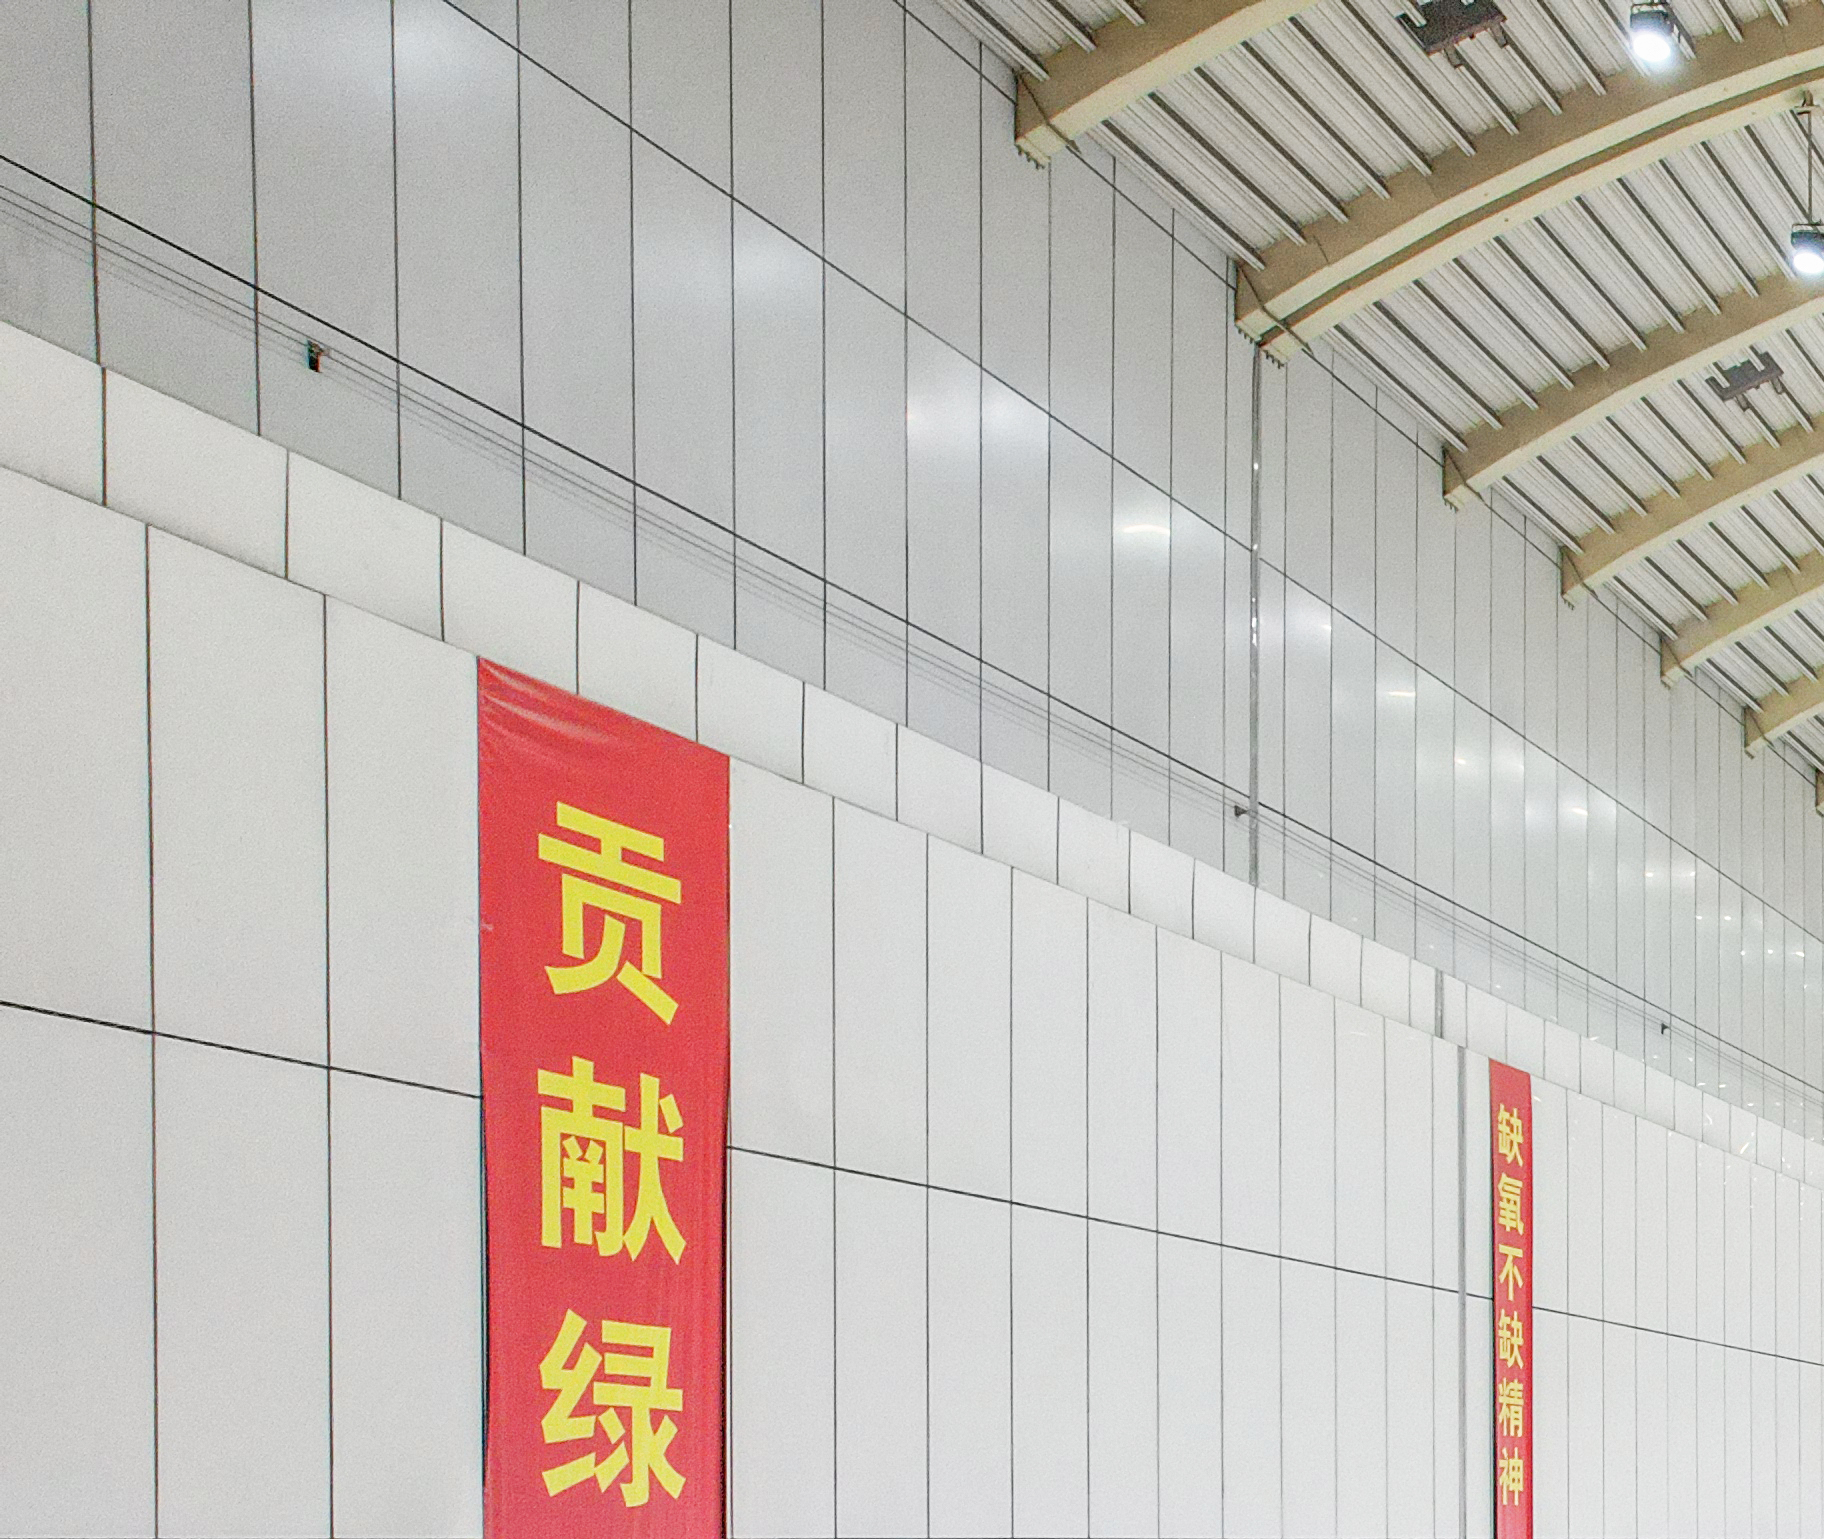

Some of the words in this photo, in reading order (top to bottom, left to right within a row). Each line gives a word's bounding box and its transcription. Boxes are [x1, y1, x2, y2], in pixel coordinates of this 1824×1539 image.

[1496, 1104, 1525, 1506] 缺氧不缺精神
